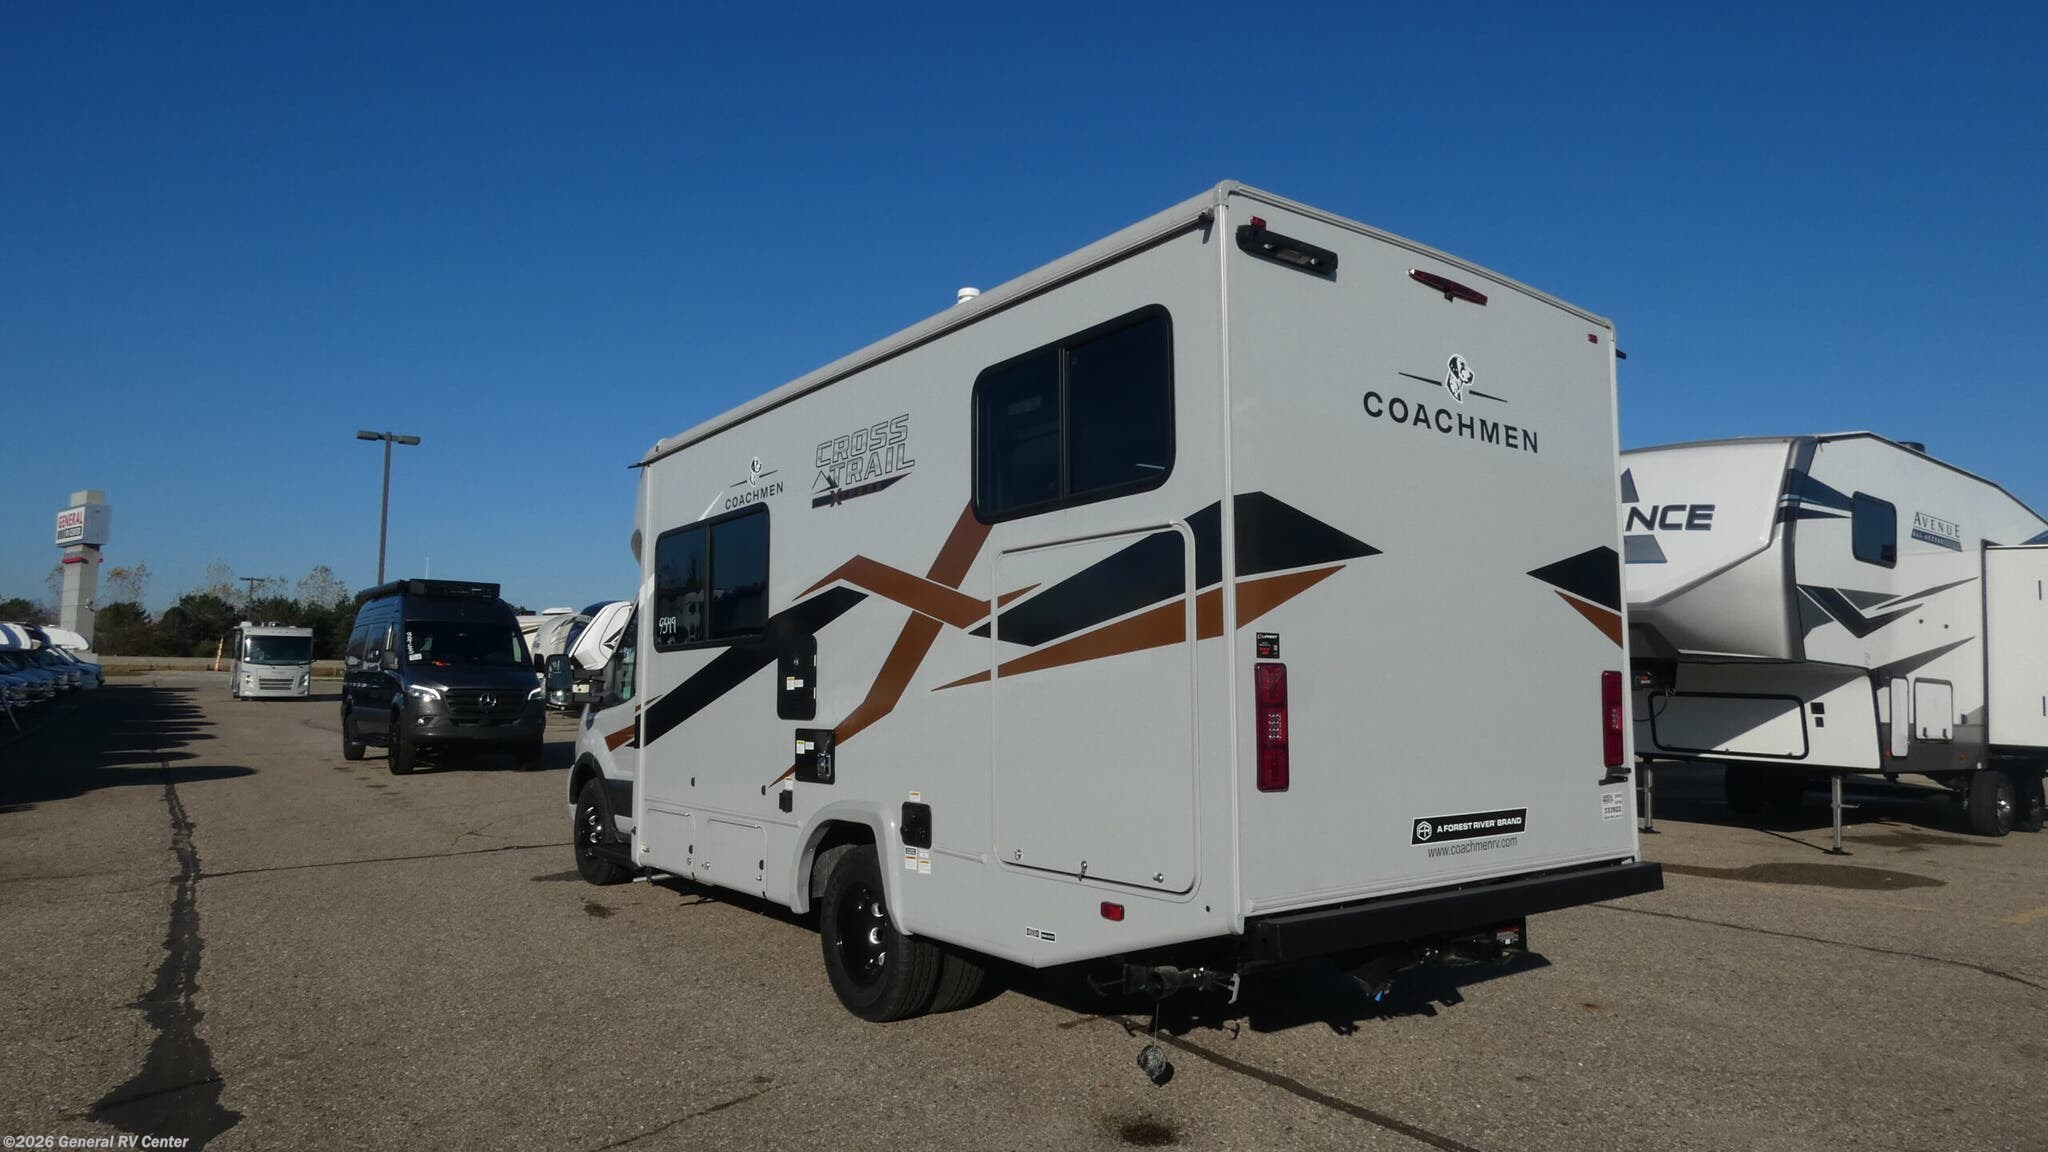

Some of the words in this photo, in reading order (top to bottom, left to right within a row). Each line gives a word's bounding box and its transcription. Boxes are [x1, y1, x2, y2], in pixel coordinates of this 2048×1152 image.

[1363, 391, 1539, 454] COACHMEN
[815, 413, 909, 468] CROSS
[829, 443, 916, 488] TRAIL
[725, 482, 784, 510] COACHMEN
[58, 512, 83, 528] GENERAL
[1913, 511, 1960, 540] AVENUE
[1436, 825, 1443, 833] A
[1444, 822, 1473, 832] FOREST
[1473, 819, 1495, 829] RIVER
[1497, 816, 1522, 827] BRAND
[1427, 836, 1518, 859] www.coachmenrv.com
